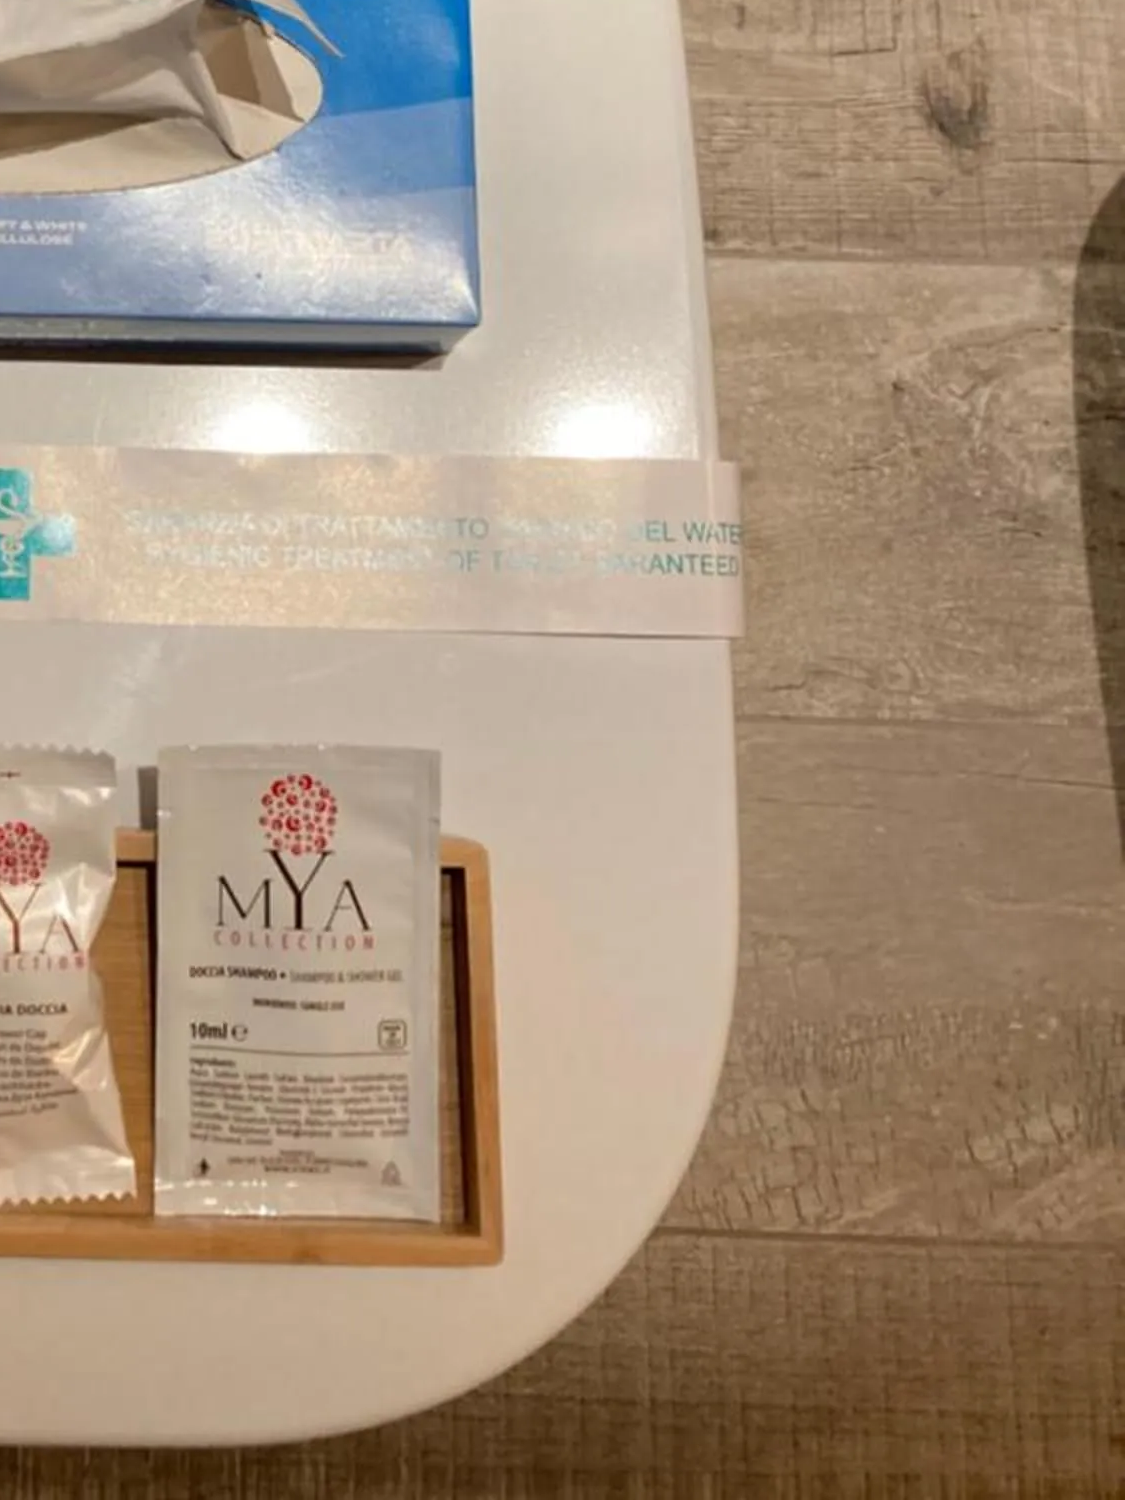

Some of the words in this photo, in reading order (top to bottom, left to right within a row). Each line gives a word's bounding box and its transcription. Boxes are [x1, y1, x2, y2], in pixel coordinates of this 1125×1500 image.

[683, 521, 742, 545] WATE
[215, 848, 372, 933] MYA
[213, 930, 375, 952] COLLECTION
[17, 1002, 68, 1016] DOCCIA
[190, 1022, 228, 1040] 10ml
